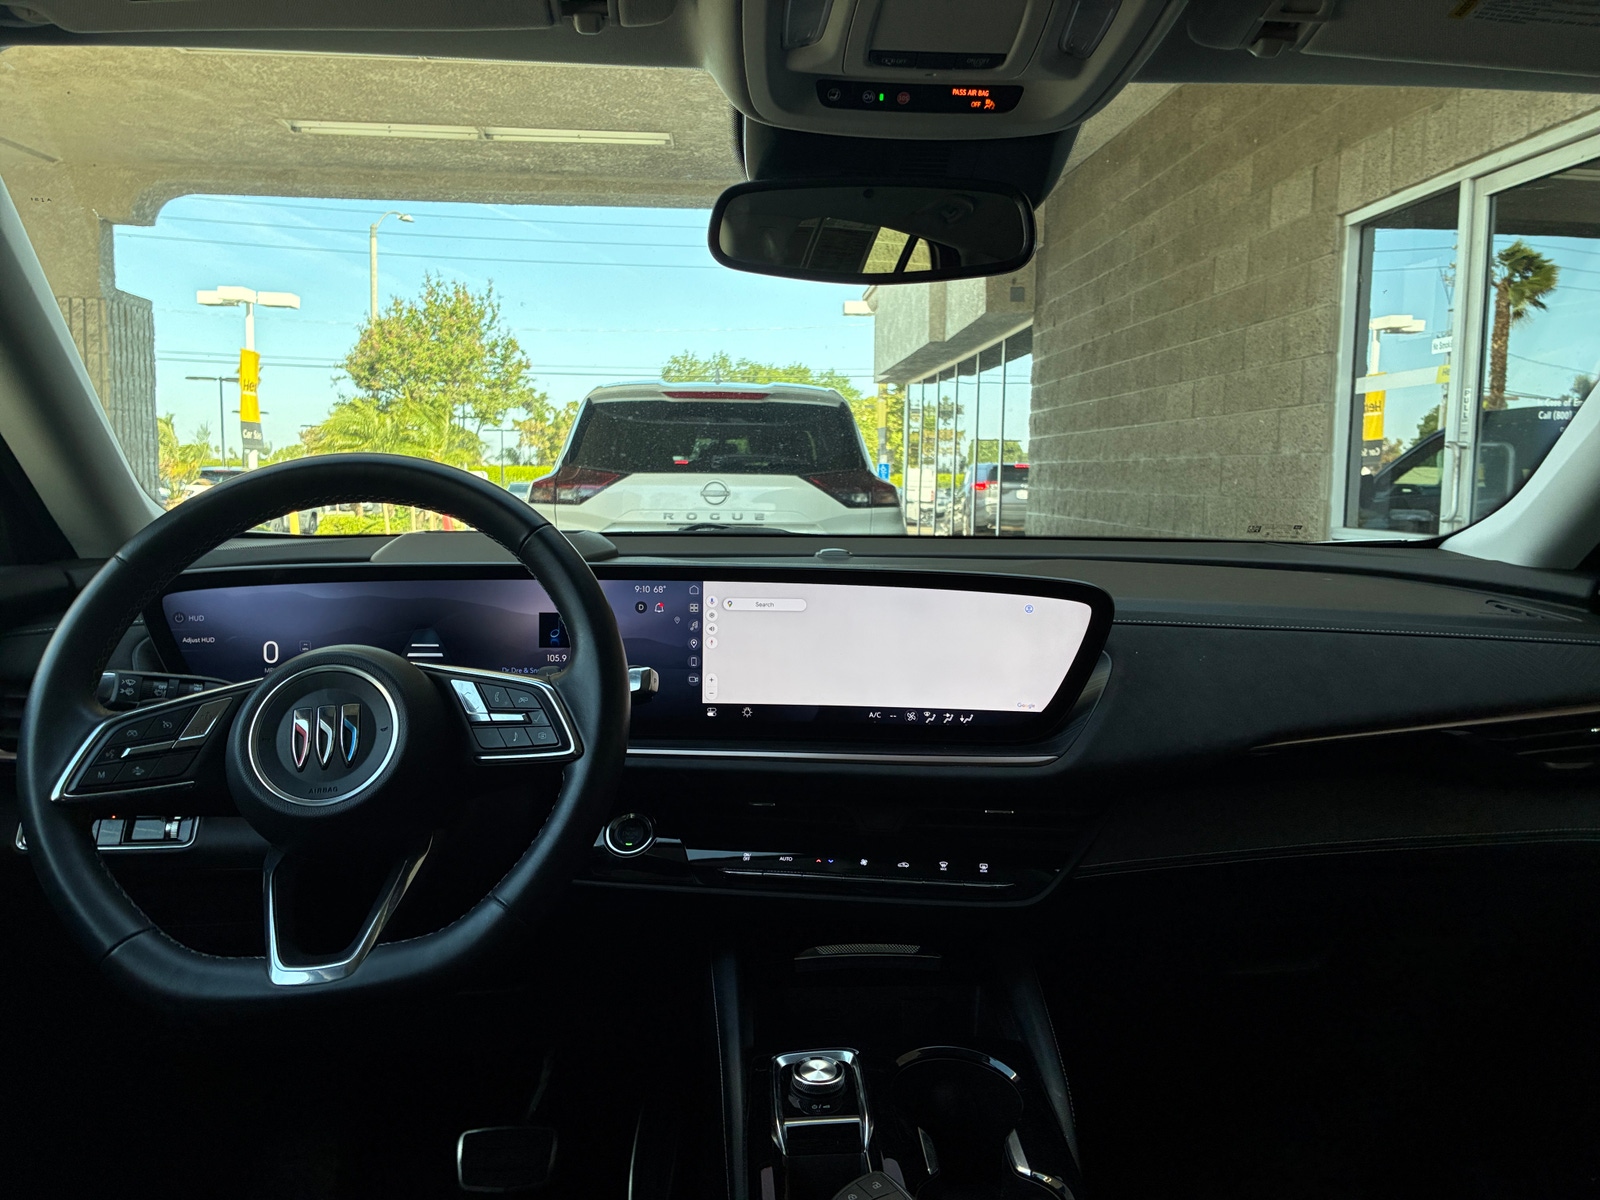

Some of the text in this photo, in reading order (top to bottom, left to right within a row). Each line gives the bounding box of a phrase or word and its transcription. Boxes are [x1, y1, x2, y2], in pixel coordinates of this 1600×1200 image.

[952, 88, 989, 98] PASS AIR BAG
[1538, 410, 1552, 420] Call
[663, 512, 766, 521] ROGUE
[634, 584, 666, 594] 9:10 68°
[182, 636, 200, 644] Adjust
[262, 640, 279, 664] 0
[546, 654, 567, 662] 105.9
[511, 666, 523, 674] Dre
[1016, 701, 1035, 710] Google
[868, 711, 882, 719] A/C
[308, 786, 338, 794] AIRBAG
